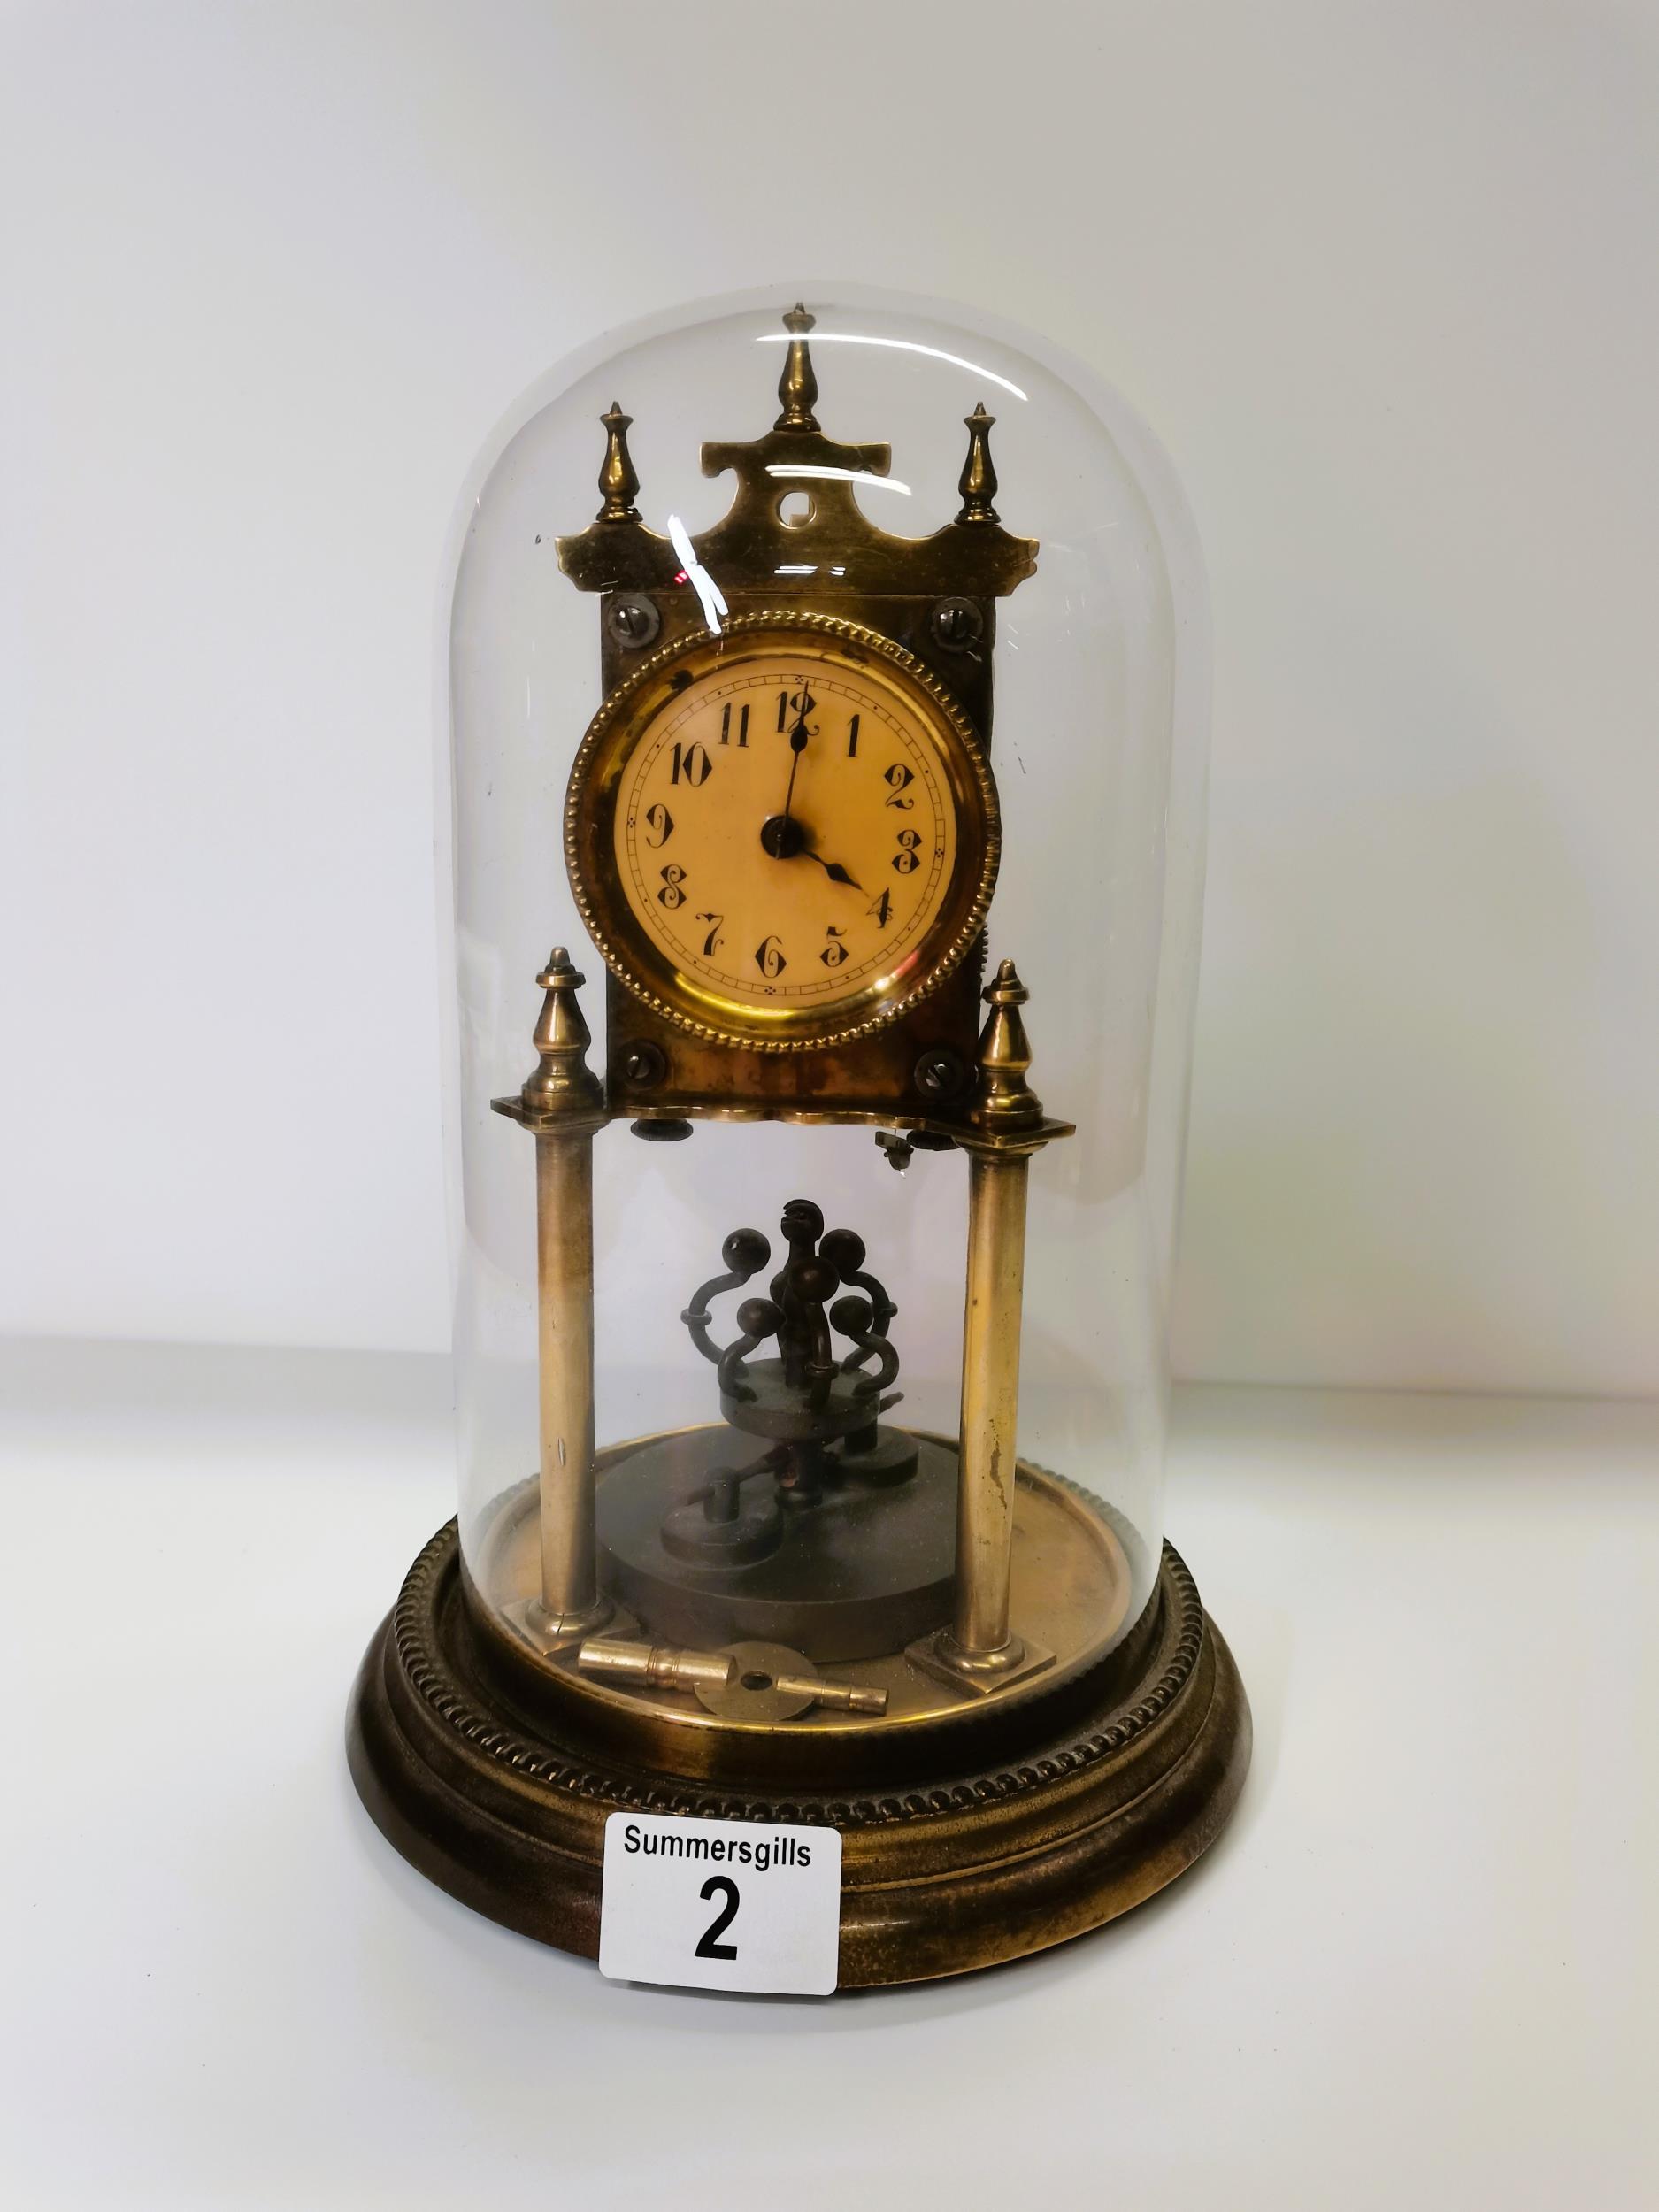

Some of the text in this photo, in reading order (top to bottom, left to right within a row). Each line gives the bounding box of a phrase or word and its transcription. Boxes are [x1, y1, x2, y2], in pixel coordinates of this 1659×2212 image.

[718, 702, 751, 748] 11
[774, 690, 820, 734] 12
[846, 713, 860, 758] 1
[670, 741, 713, 787] 10
[884, 764, 915, 810] 2
[646, 803, 674, 849] 9
[891, 829, 922, 874] 3
[657, 864, 687, 910] 8
[865, 887, 894, 929] 4
[695, 912, 724, 956] 7
[755, 935, 787, 978] 6
[819, 926, 849, 967] 5
[624, 1824, 811, 1871] Summersgills
[695, 1875, 741, 1961] 2
